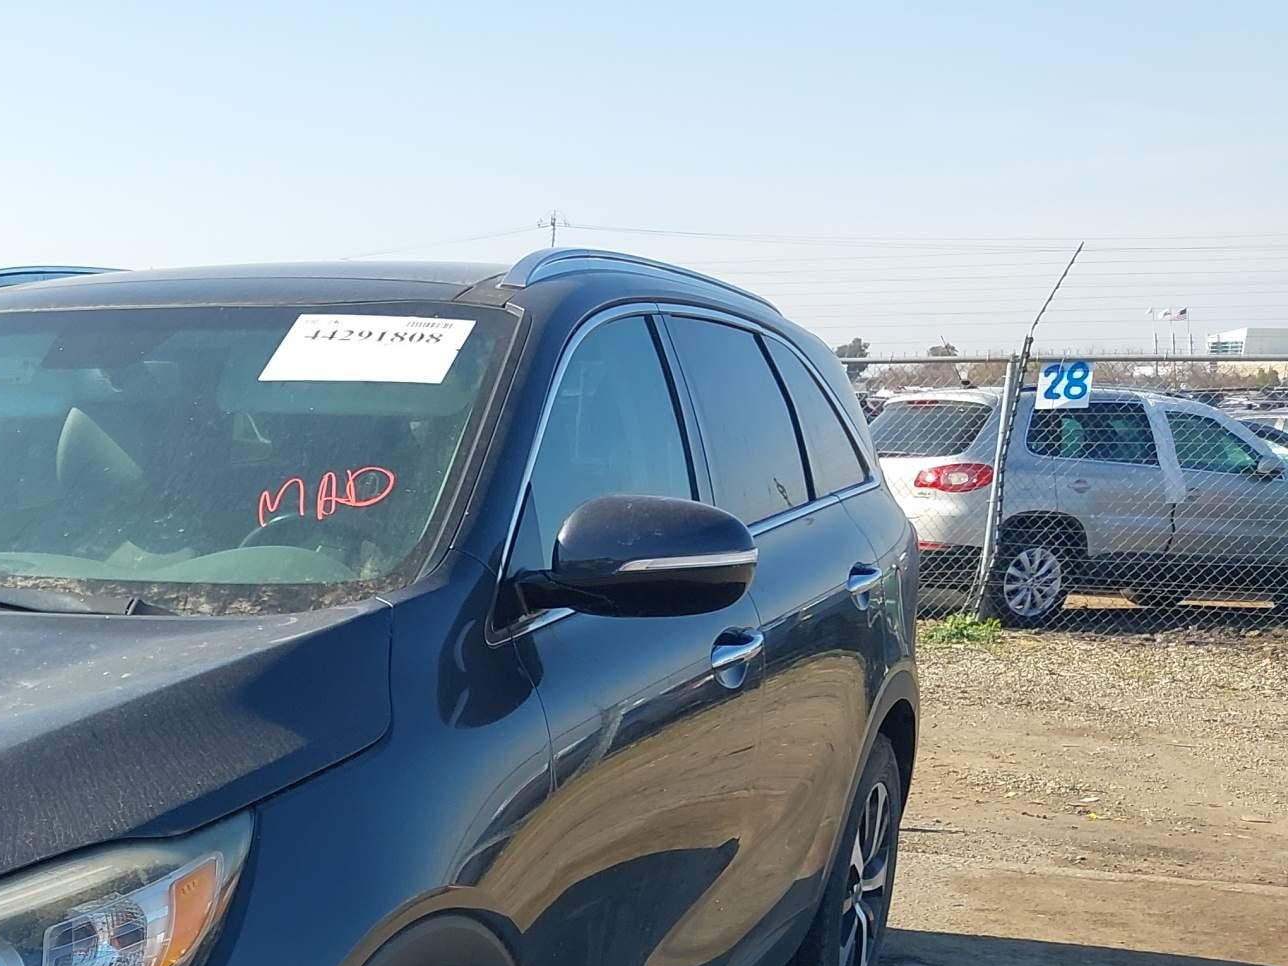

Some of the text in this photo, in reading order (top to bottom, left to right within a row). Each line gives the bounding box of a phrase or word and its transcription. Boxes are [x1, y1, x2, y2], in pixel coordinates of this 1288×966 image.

[304, 329, 444, 344] 44291808
[1043, 360, 1090, 400] 28
[258, 465, 396, 528] MAD
